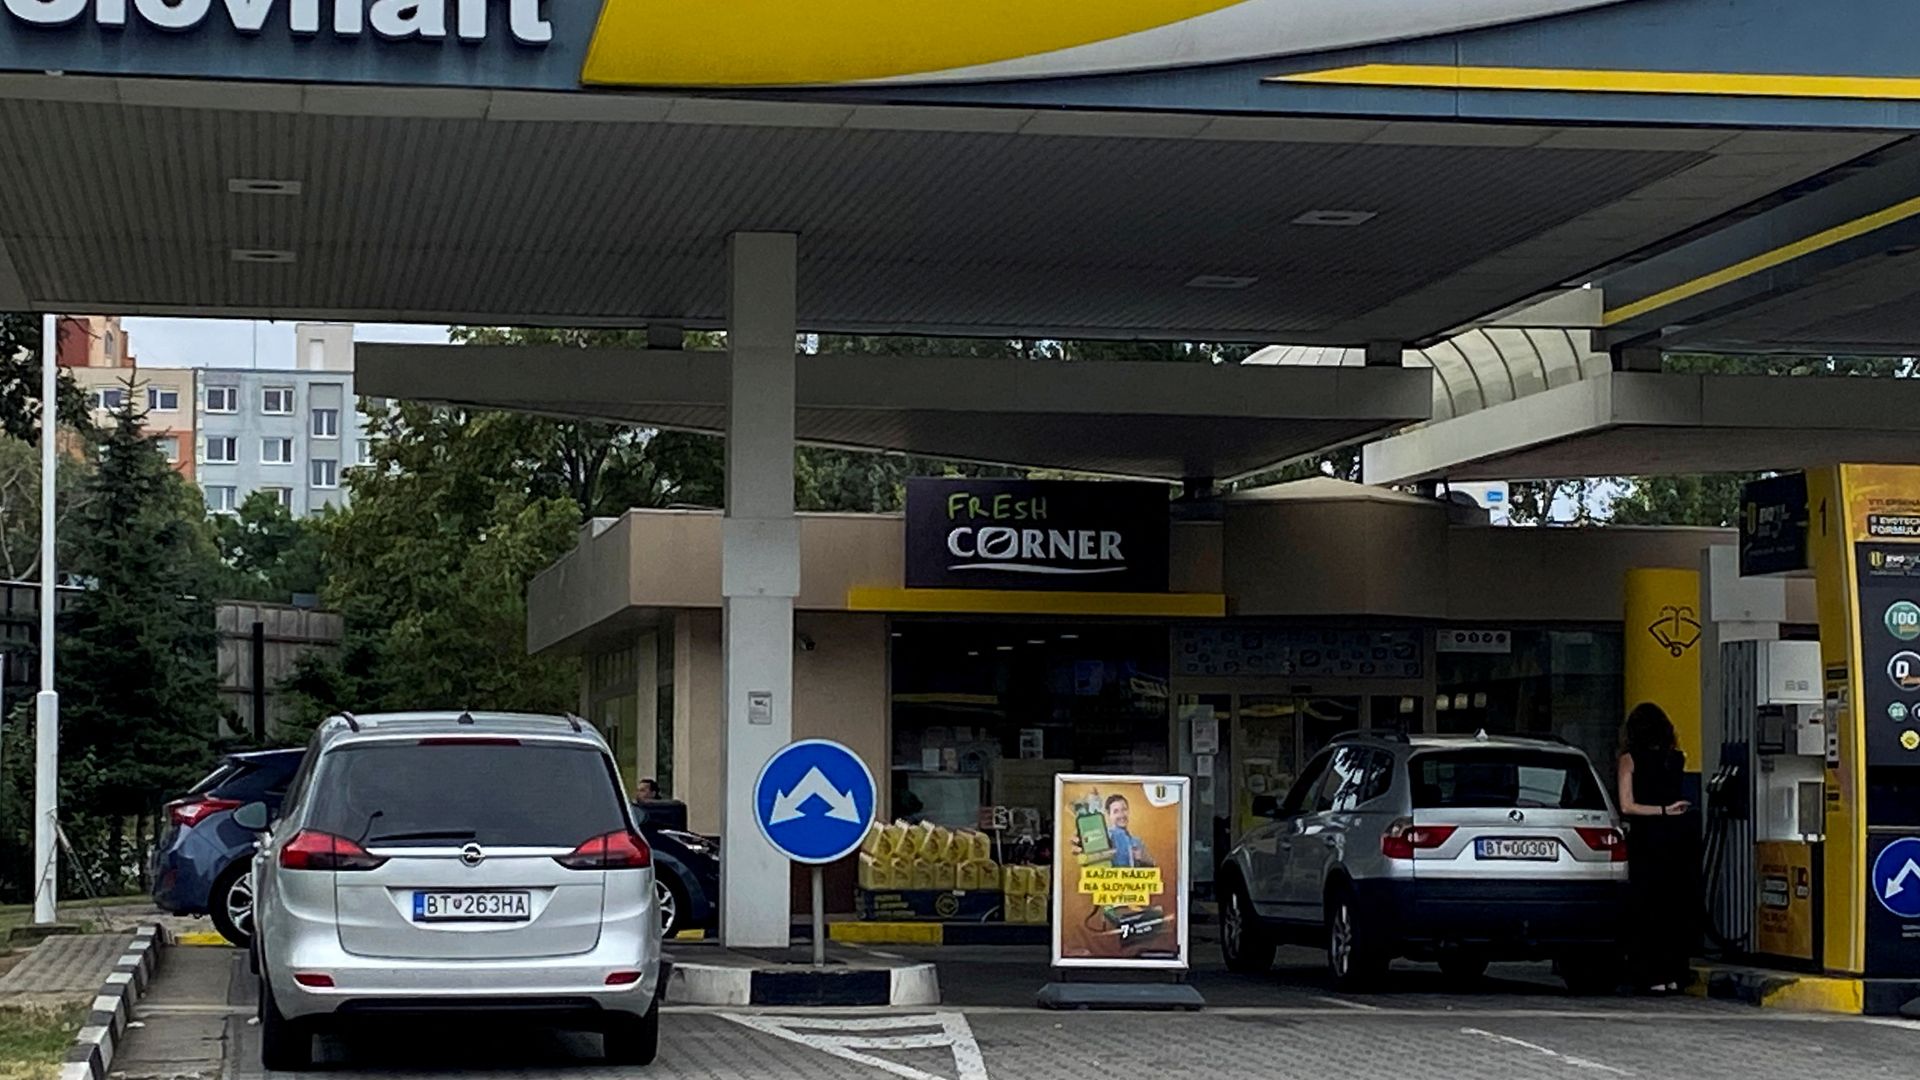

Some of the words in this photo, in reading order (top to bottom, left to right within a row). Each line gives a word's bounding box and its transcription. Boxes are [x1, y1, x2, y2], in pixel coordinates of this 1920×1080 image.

[948, 493, 1047, 520] FRESH
[1819, 497, 1827, 536] 1
[947, 527, 1125, 559] CORNER
[1892, 611, 1918, 625] 100
